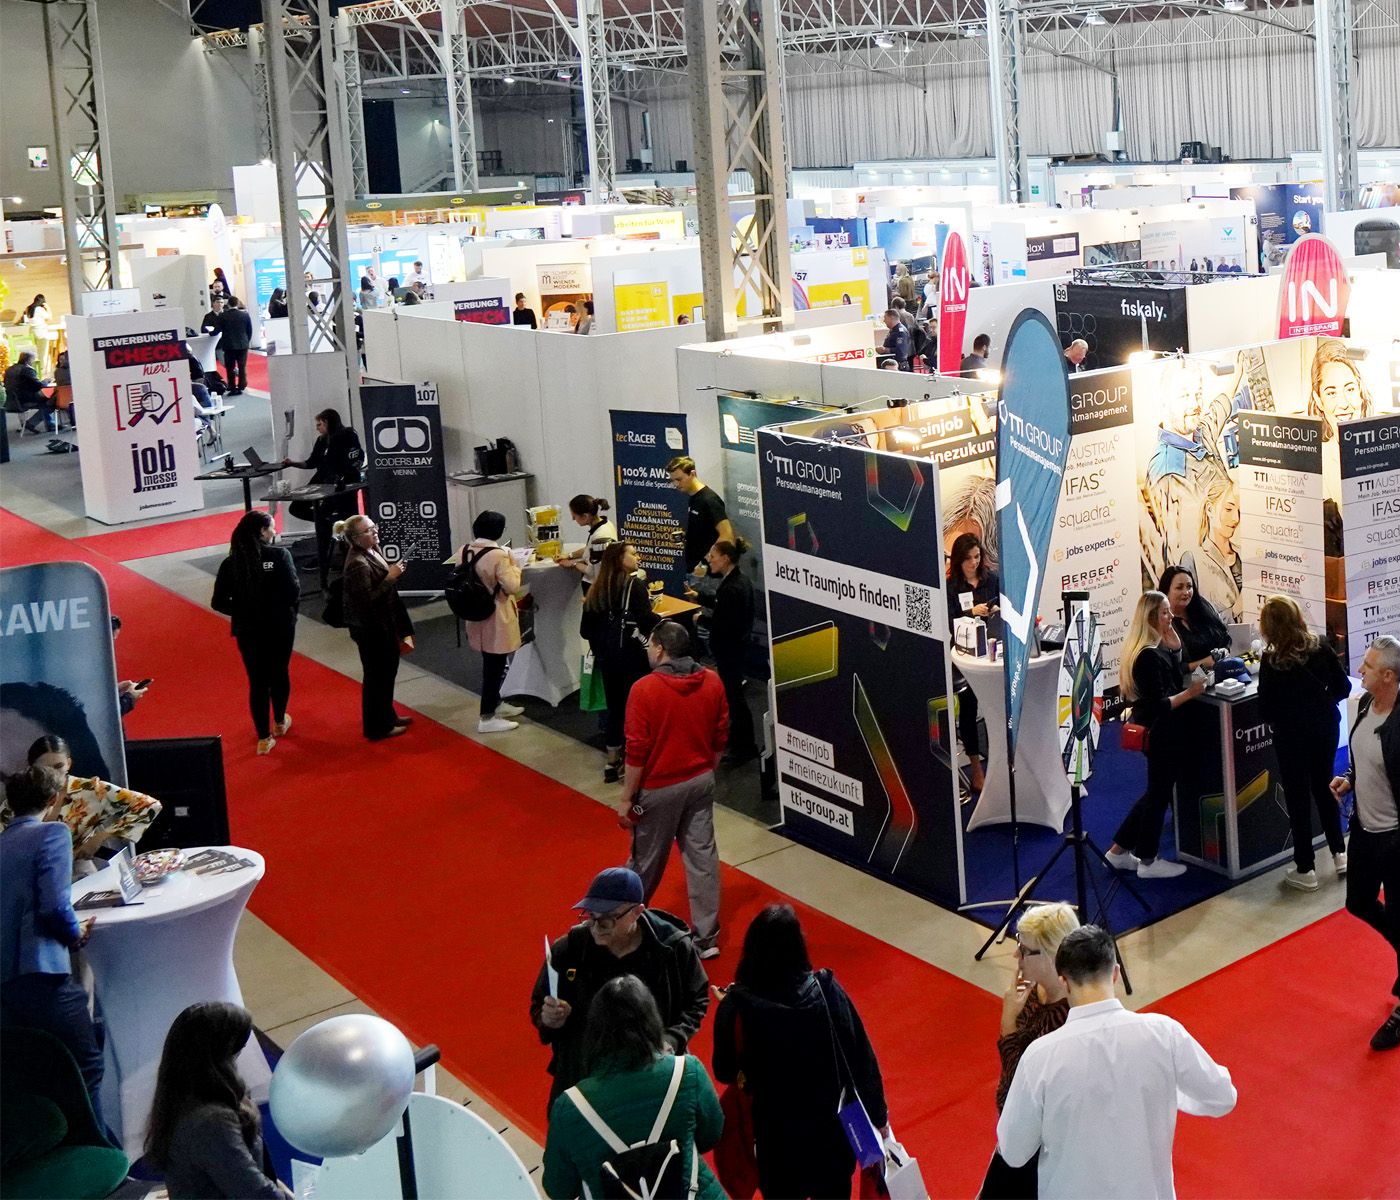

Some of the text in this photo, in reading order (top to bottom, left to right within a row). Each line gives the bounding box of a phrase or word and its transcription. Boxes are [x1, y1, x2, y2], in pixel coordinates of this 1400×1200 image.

[796, 272, 807, 281] 57
[943, 266, 966, 302] IN
[1056, 289, 1067, 300] 99
[1288, 278, 1338, 323] IN
[1121, 299, 1167, 322] fiskaly.
[97, 332, 173, 349] BEWERBUNGS
[109, 343, 183, 365] CHECK
[817, 350, 864, 363] RSPAR
[416, 389, 436, 402] 107
[1071, 385, 1128, 411] GROUP
[919, 415, 964, 438] einjob
[1250, 423, 1318, 442] TTI GROUP
[1008, 412, 1063, 458] TTI GROUP
[1352, 430, 1375, 445] TTI
[1251, 437, 1318, 453] Personalmanagement
[131, 438, 176, 494] job
[374, 457, 433, 467] CODERS.BAY
[143, 471, 178, 486] messe
[392, 468, 417, 477] VIENNA
[622, 466, 648, 478] 100%
[773, 455, 842, 486] TTI GROUP
[1254, 471, 1269, 483] TTI
[775, 476, 843, 501] Personalmanagement
[1065, 473, 1101, 496] IFAS
[1357, 479, 1374, 492] TTI
[633, 507, 672, 518] CONSULTING
[637, 500, 668, 511] TRAINING
[1265, 496, 1292, 513] IFAS
[626, 513, 680, 526] DATA&ANALYTICS
[1059, 504, 1111, 529] squadra
[620, 528, 651, 539] DATALAKE
[623, 521, 655, 531] MANAGED
[654, 546, 684, 557] CONNECT
[1066, 545, 1084, 560] jobs
[1084, 537, 1116, 552] experts
[1264, 549, 1303, 563] jobs experts
[638, 560, 674, 571] SERVERLESS
[1371, 558, 1388, 569] jobs
[1061, 564, 1114, 588] BERGER
[1260, 570, 1301, 585] BERGER
[775, 560, 901, 612] Jetzt Traumjob finden!
[0, 596, 91, 637] AWE
[1056, 604, 1076, 620] TI
[1363, 605, 1380, 618] TTI
[1244, 723, 1265, 742] TTI
[786, 731, 830, 762] #meinjob
[788, 758, 860, 800] #meinezukunft
[790, 789, 850, 828] tti-group.at
